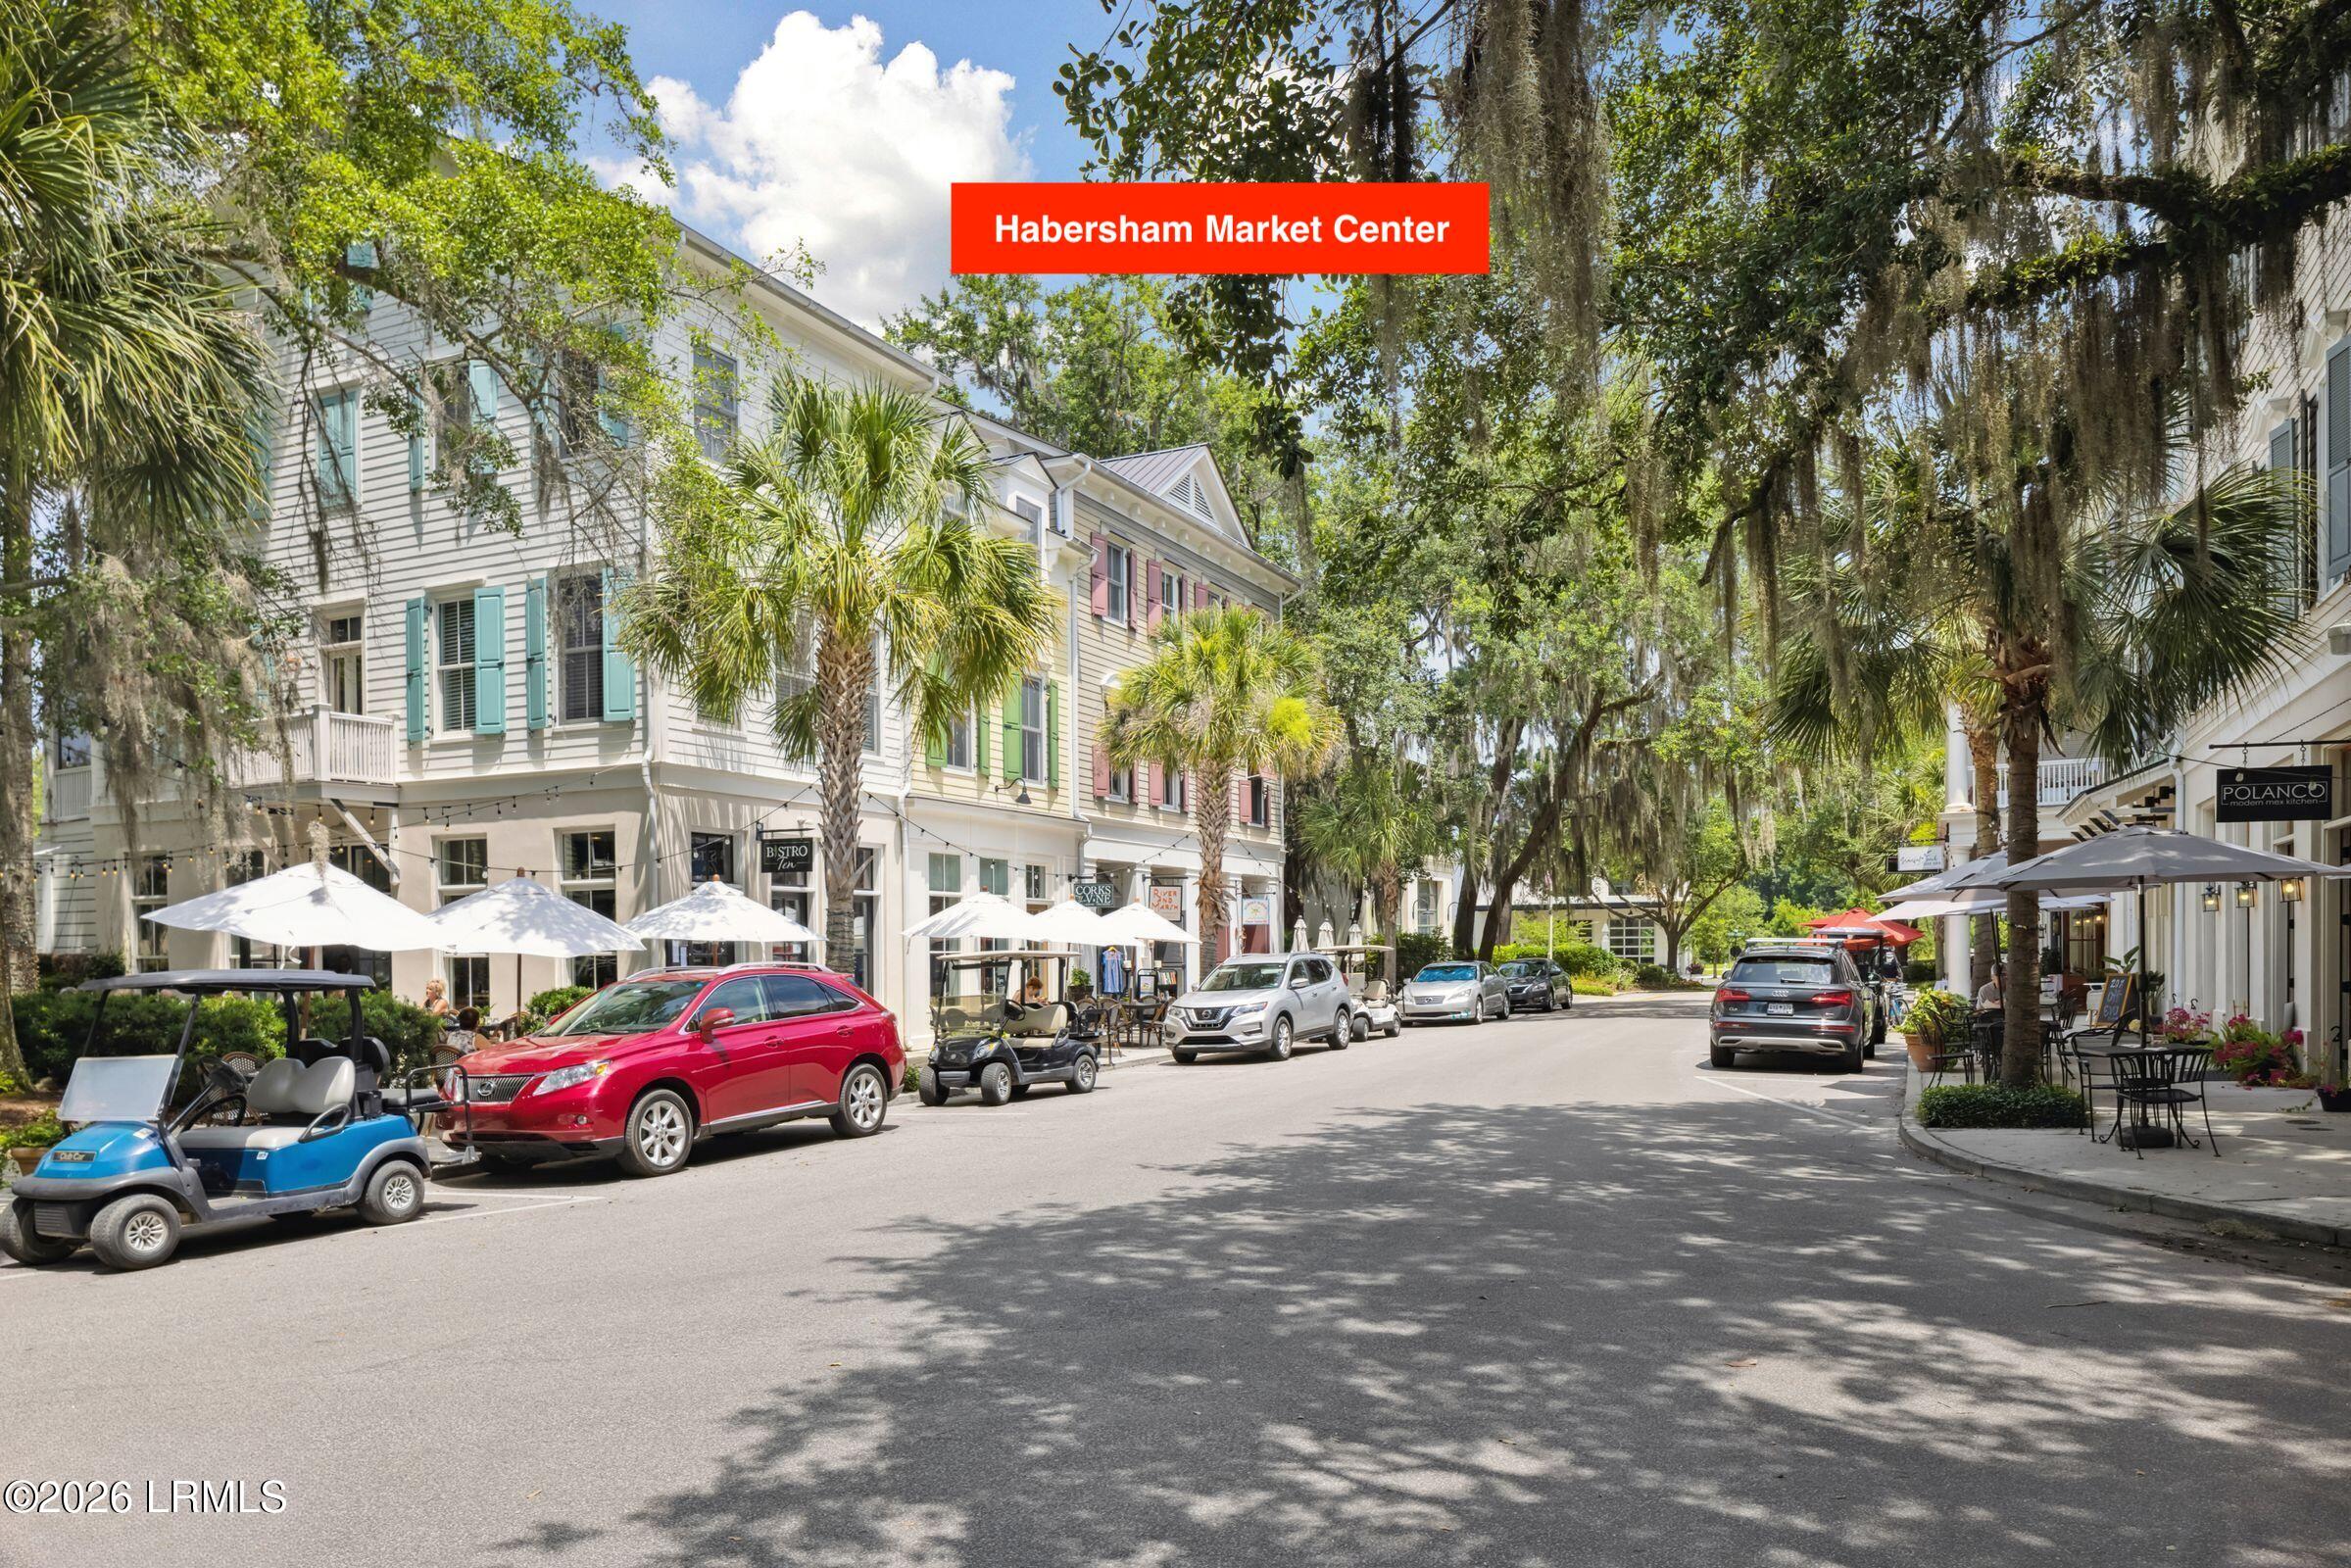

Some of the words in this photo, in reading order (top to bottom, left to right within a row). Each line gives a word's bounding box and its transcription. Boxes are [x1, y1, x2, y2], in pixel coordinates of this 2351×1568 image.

[2223, 785, 2326, 800] POLANCO
[766, 845, 808, 858] BISTRO
[777, 856, 797, 871] Ten
[1075, 885, 1111, 895] CORKS
